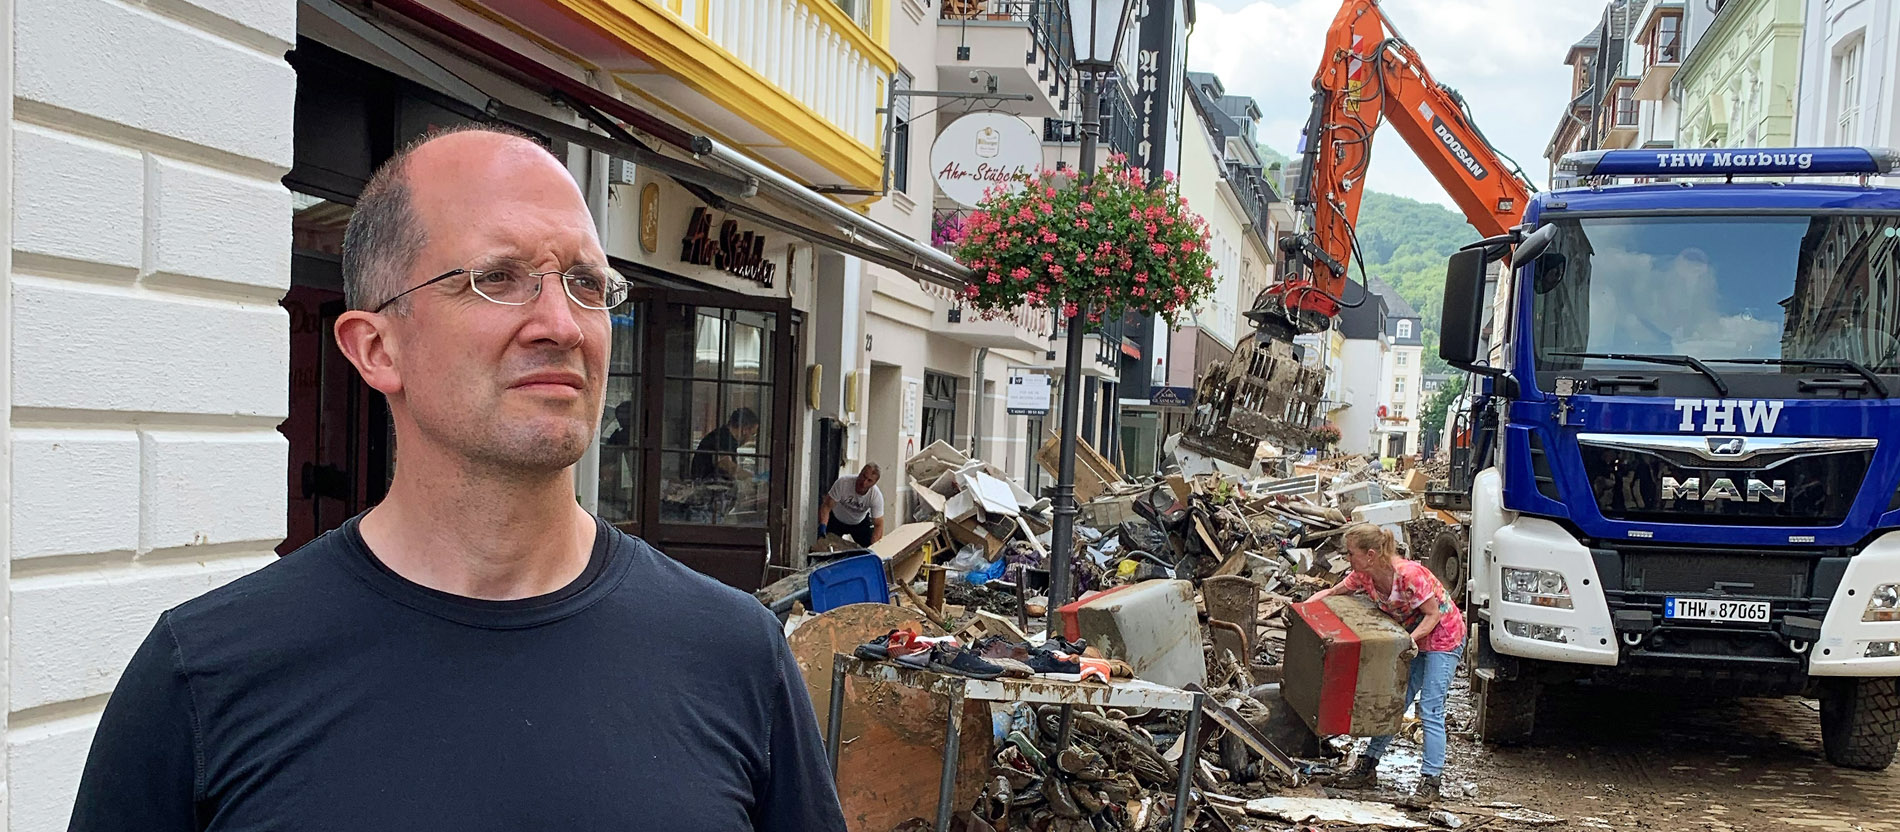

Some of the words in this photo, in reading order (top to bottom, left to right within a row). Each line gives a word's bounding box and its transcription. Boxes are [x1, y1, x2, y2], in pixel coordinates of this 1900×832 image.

[1434, 124, 1483, 177] DOOSAN
[1656, 153, 1706, 167] THW
[1712, 152, 1812, 169] Marburg
[1674, 399, 1784, 433] THW
[1661, 476, 1786, 503] MAN
[1679, 601, 1707, 617] THW
[1719, 603, 1766, 619] 87065
